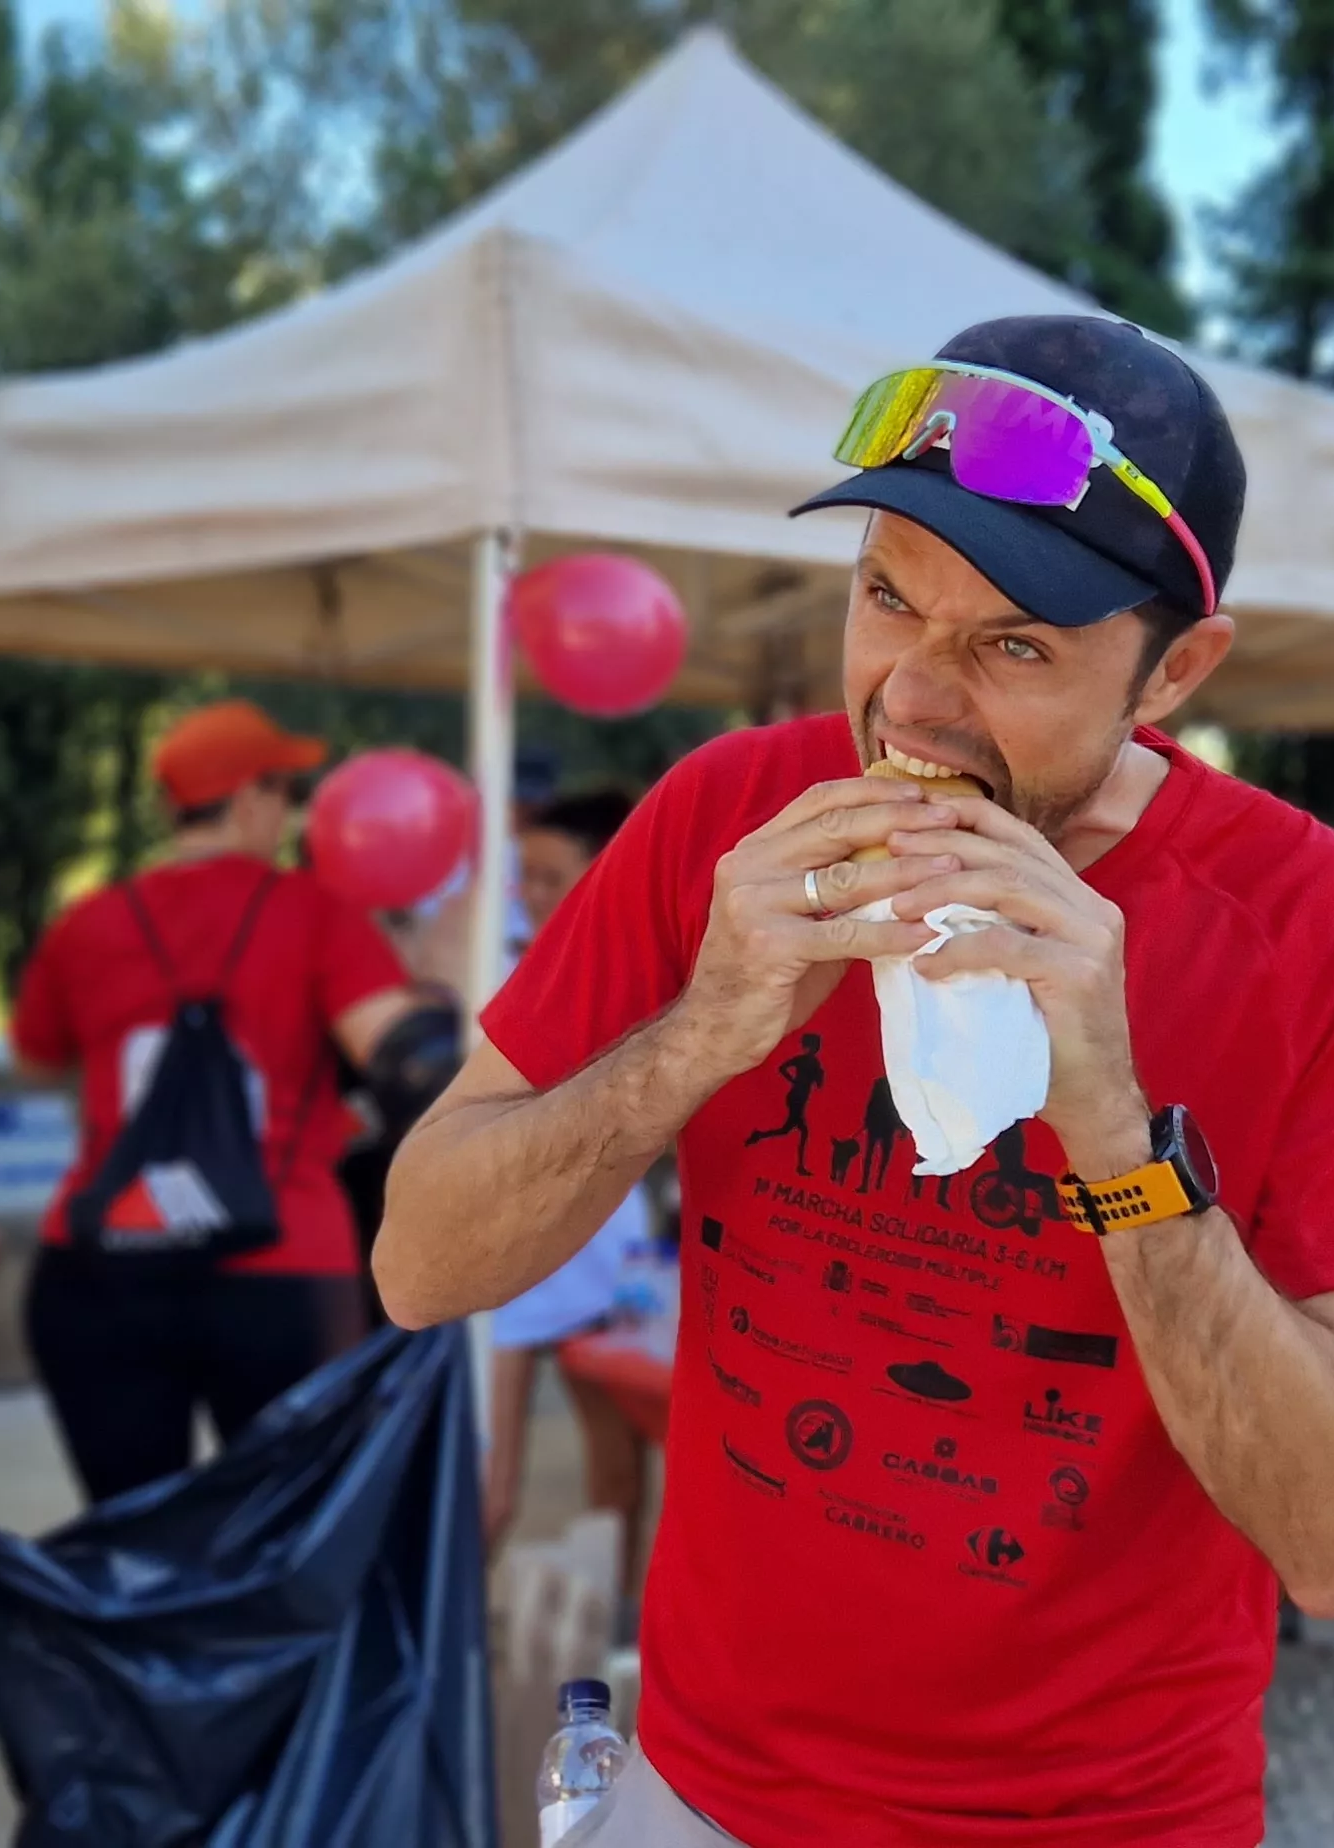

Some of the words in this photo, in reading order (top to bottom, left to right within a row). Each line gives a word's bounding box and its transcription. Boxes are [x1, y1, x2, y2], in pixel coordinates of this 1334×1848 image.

[772, 1182, 863, 1228] MARCHA
[870, 1212, 987, 1259] SOLIDARIA
[1032, 1254, 1067, 1281] KM
[804, 1225, 825, 1243] LA
